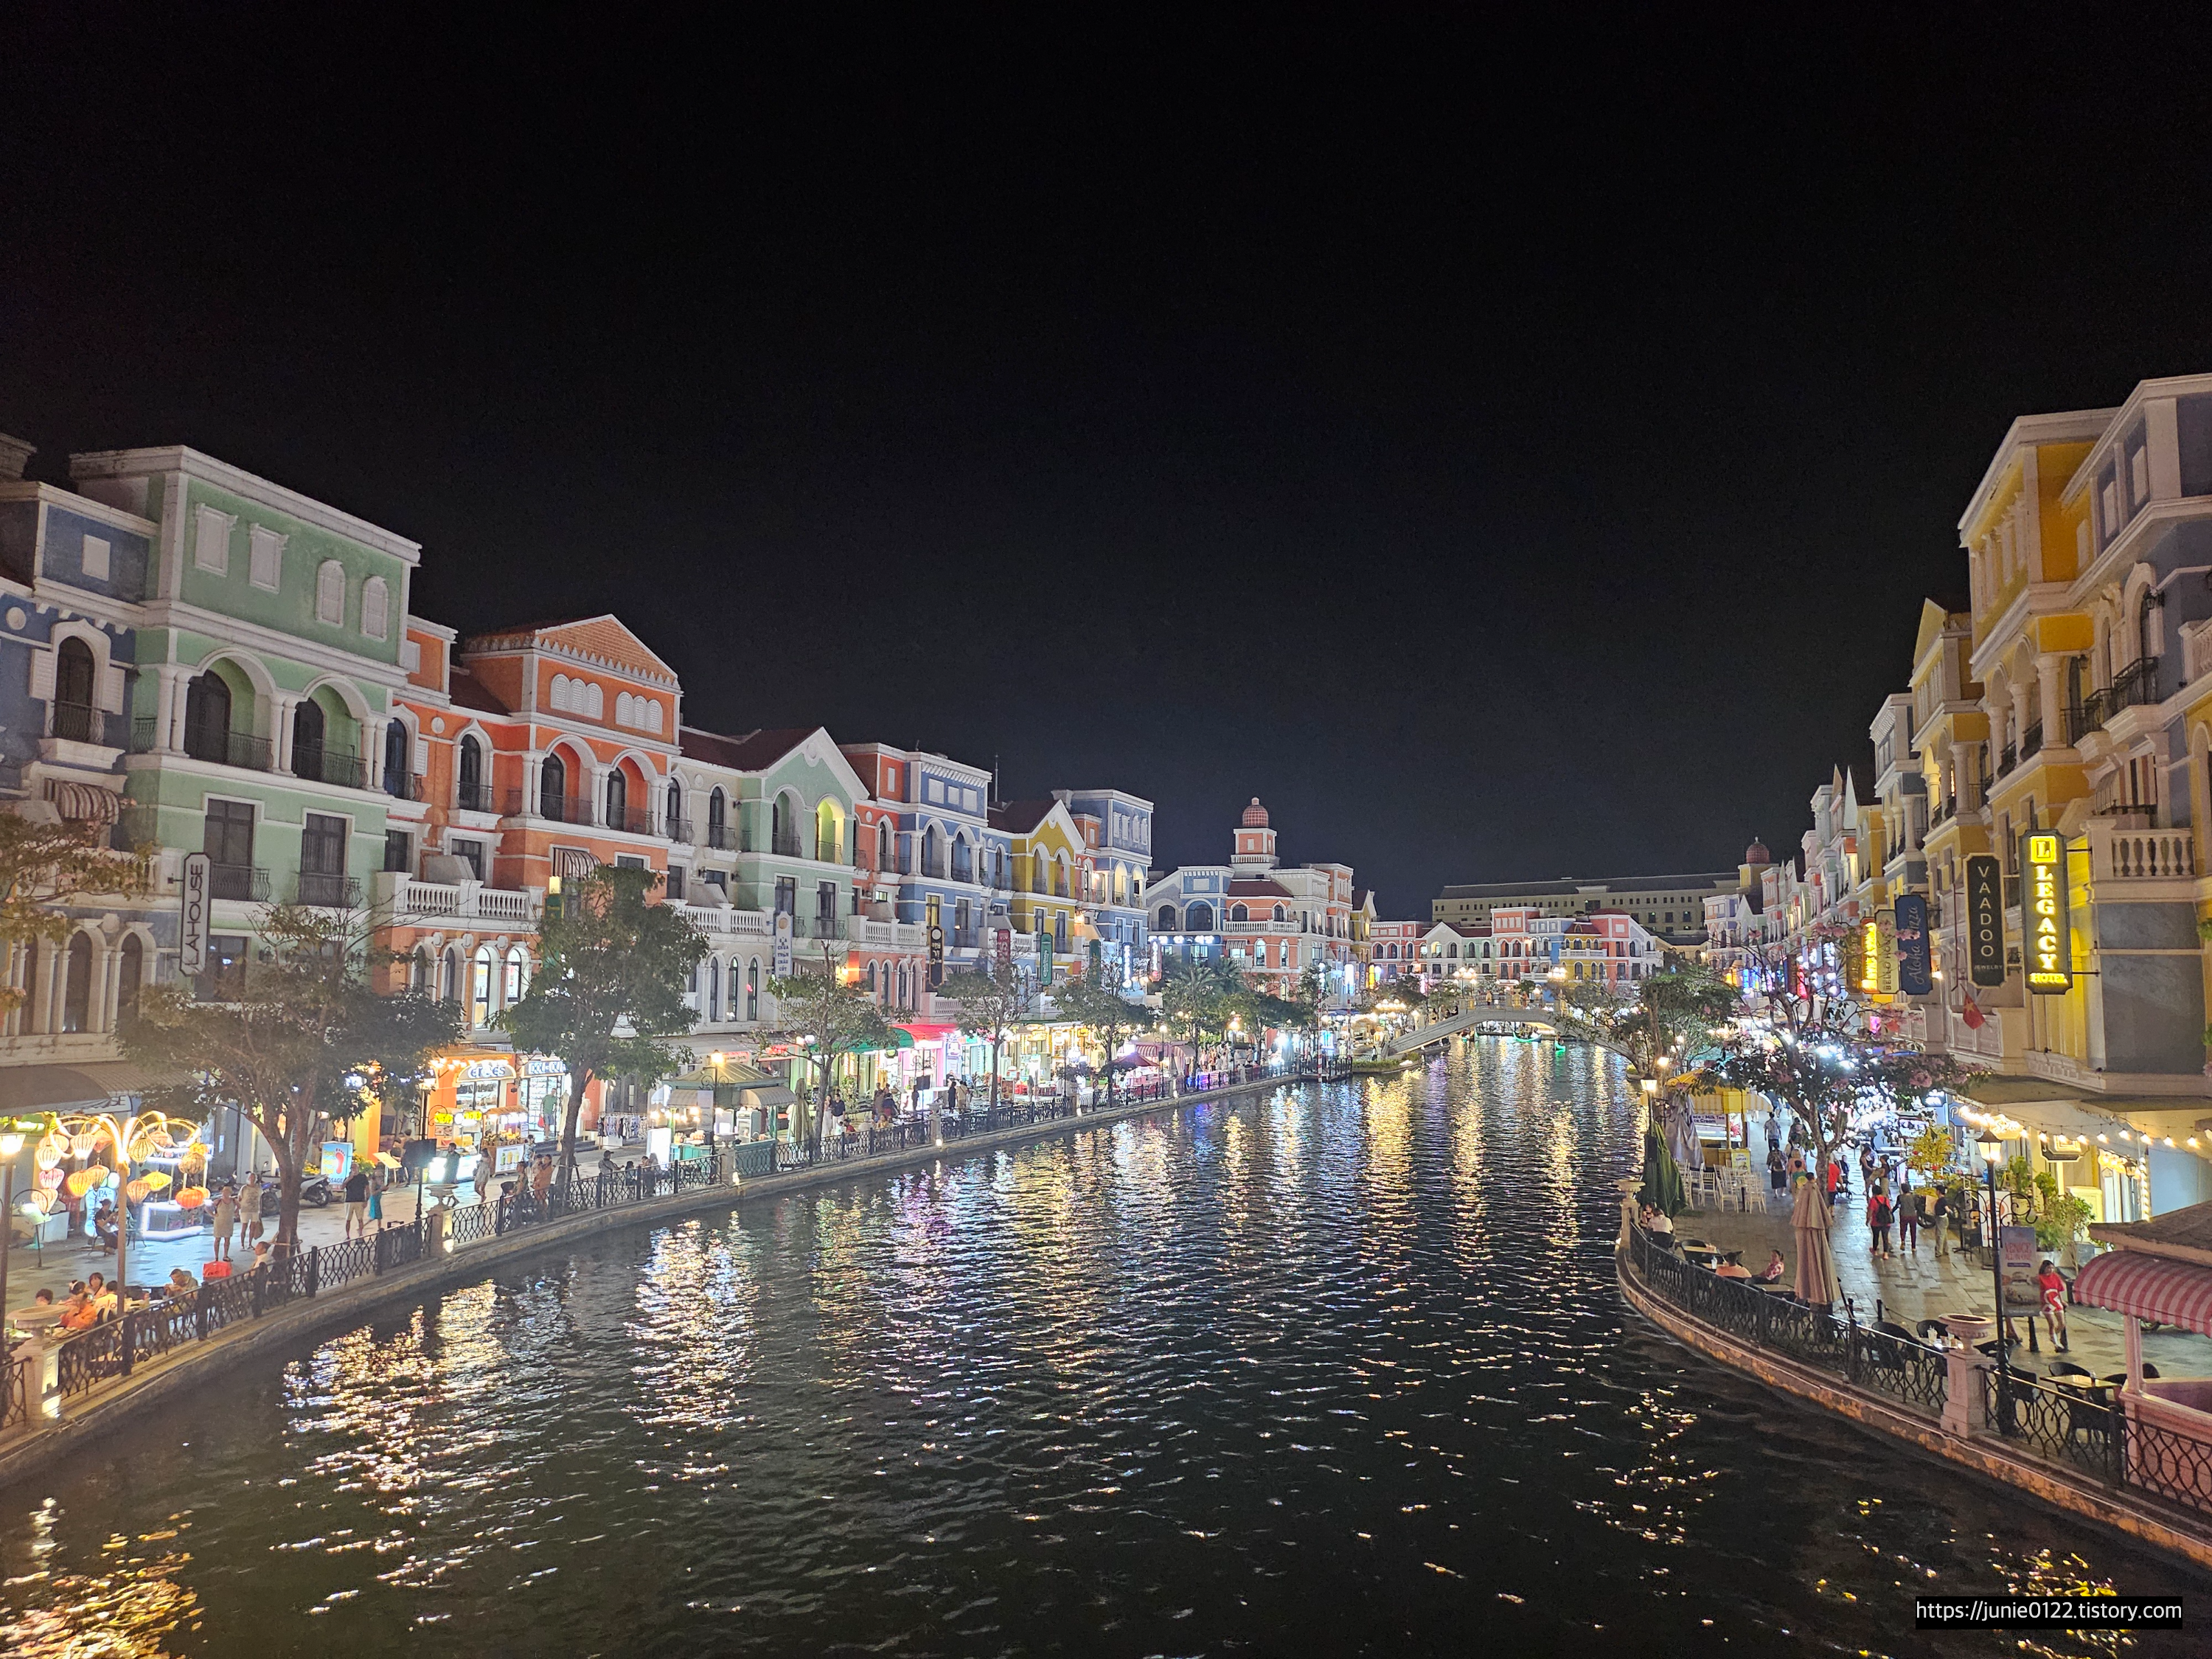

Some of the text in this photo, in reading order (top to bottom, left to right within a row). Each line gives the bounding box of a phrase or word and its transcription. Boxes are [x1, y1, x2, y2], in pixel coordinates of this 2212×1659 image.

[185, 863, 204, 965] LAHOUSE
[1978, 866, 1994, 957] VAADOO
[2035, 865, 2057, 970] LEGACY
[1882, 961, 1892, 990] BELLO
[1907, 945, 1924, 985] Aloha
[2030, 973, 2068, 985] HOTEL
